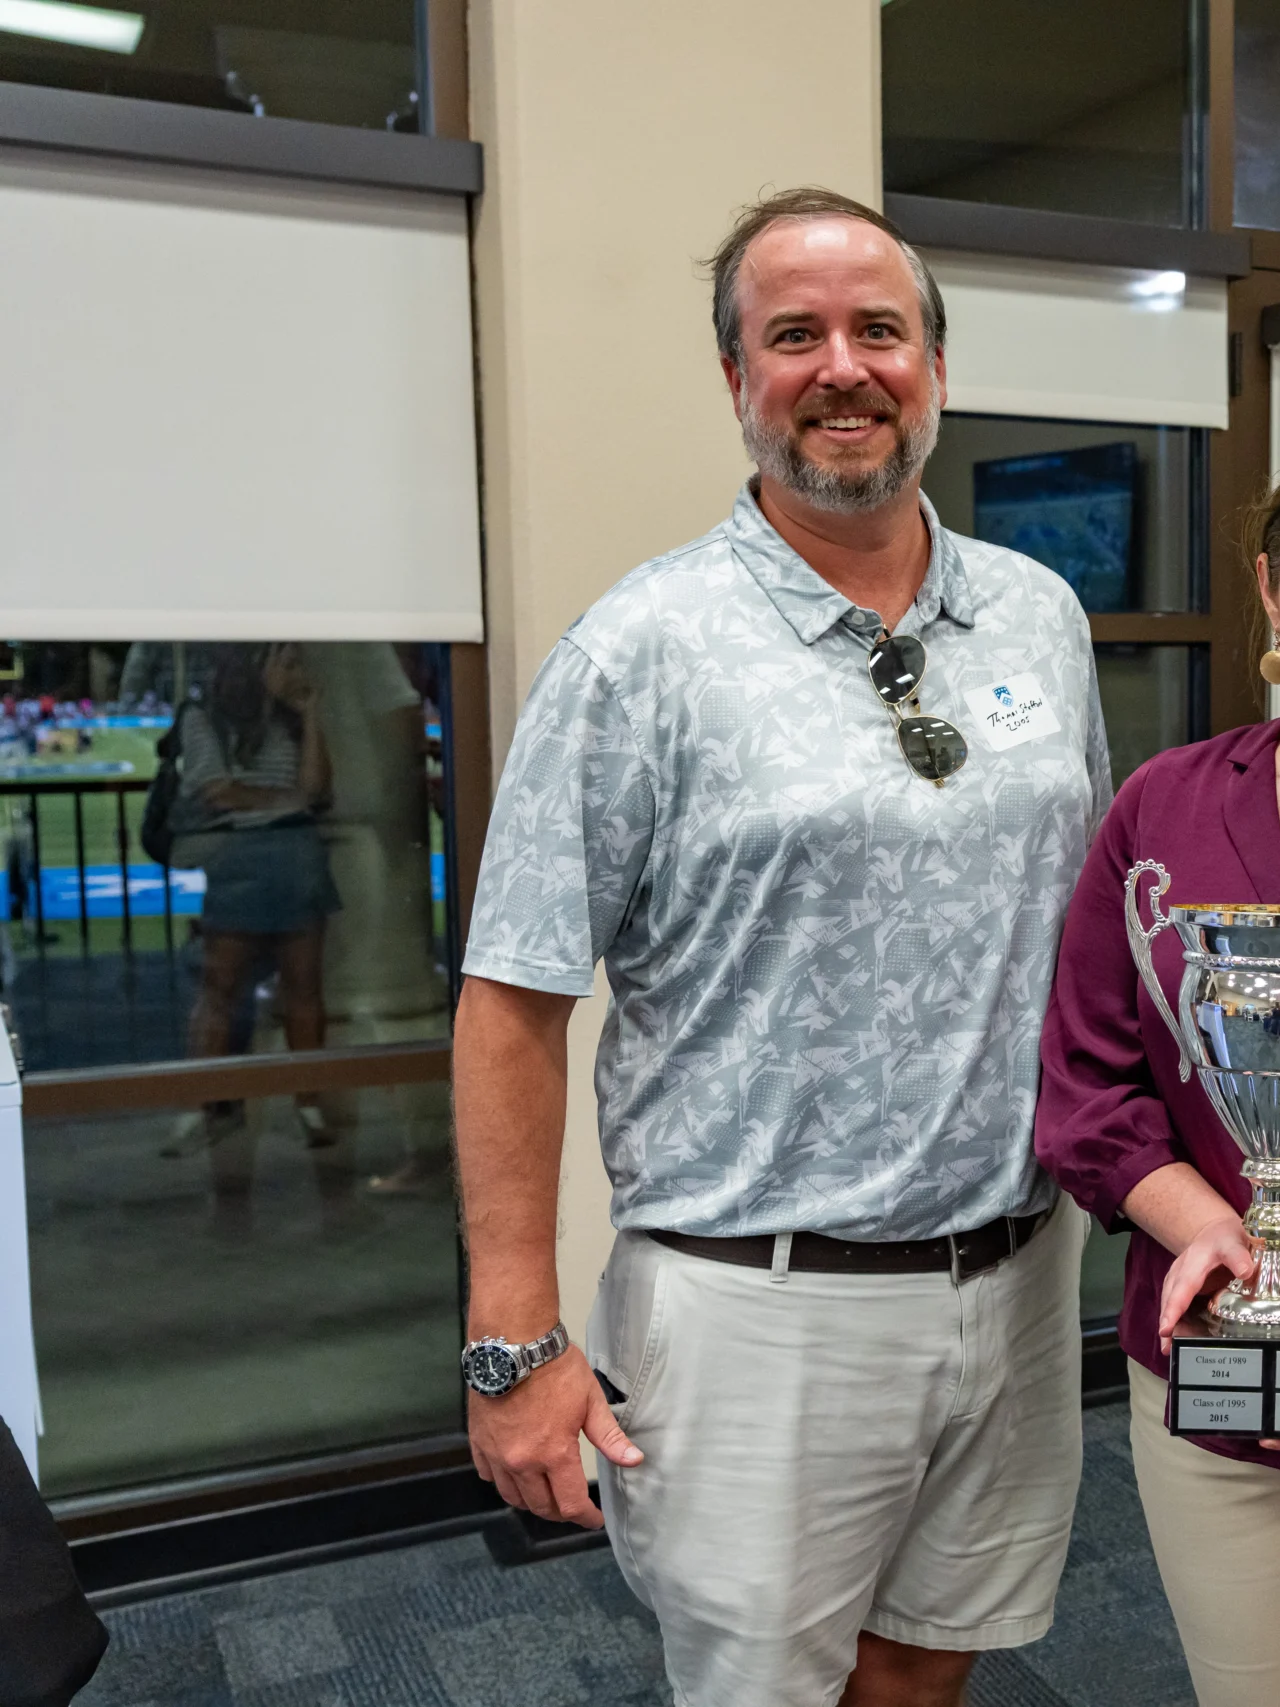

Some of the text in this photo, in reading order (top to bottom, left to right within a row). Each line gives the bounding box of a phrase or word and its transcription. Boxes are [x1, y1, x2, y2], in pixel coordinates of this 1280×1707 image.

[1005, 716, 1030, 732] 2005
[1195, 1356, 1247, 1365] Class of 1989
[1211, 1370, 1230, 1378] 2014
[1192, 1398, 1246, 1408] Class of 1995
[1209, 1414, 1229, 1422] 2015
